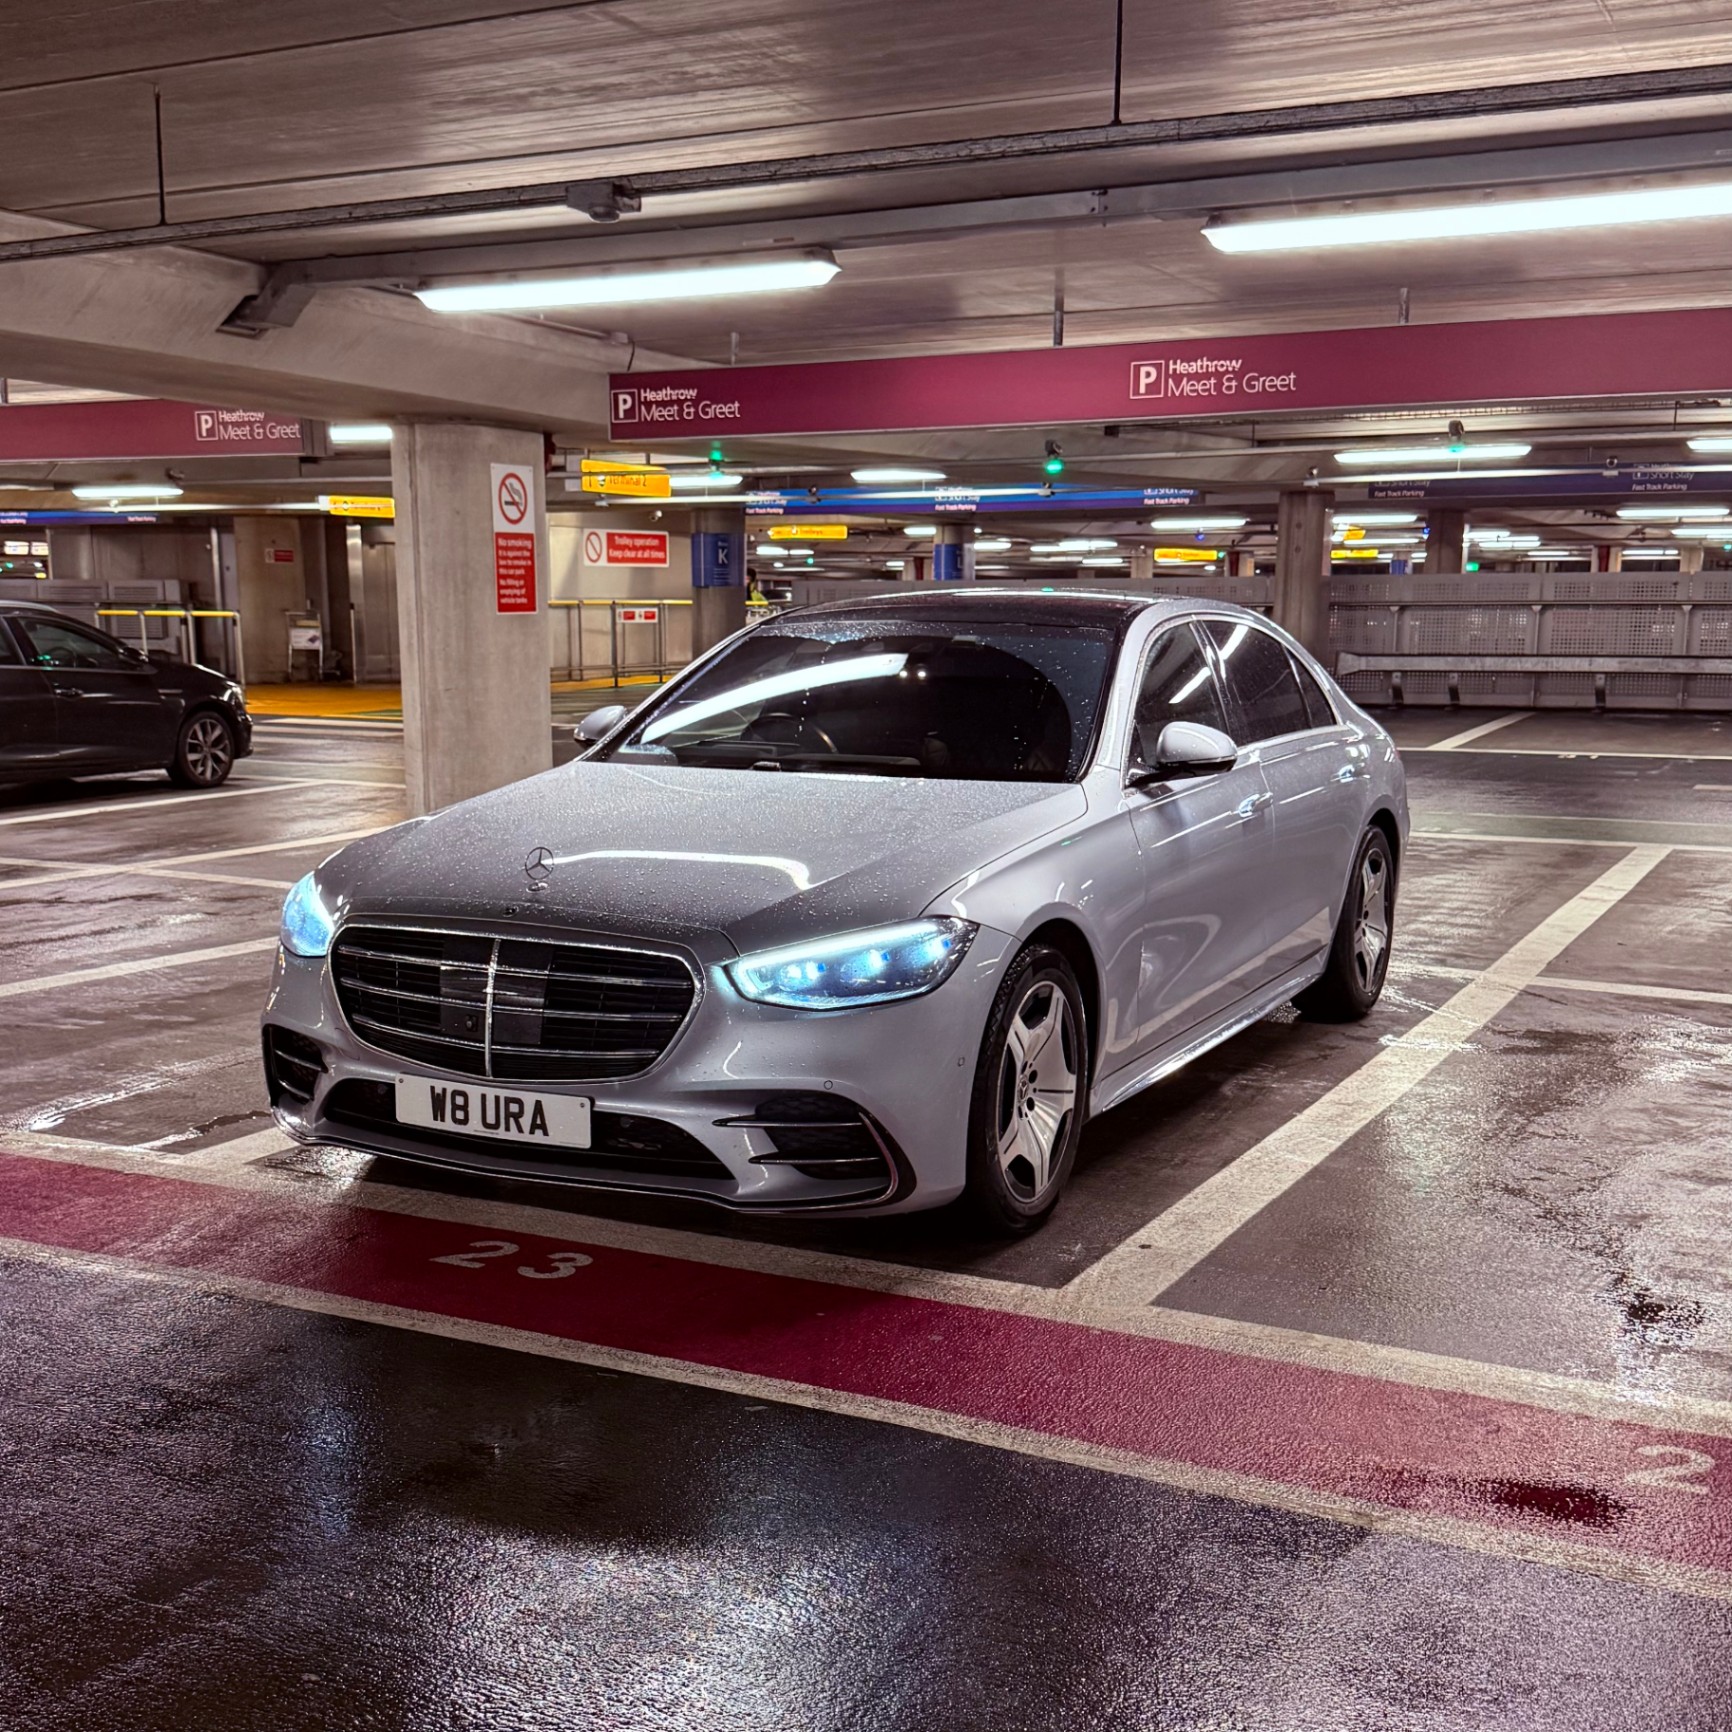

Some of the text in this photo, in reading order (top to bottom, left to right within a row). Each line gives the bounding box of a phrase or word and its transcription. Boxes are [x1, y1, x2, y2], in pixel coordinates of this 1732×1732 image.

[1168, 356, 1242, 375] Heathrow
[1139, 366, 1157, 394] P
[1168, 372, 1297, 397] Meet & Greet
[640, 386, 698, 402] Heathrow
[618, 394, 632, 419] P
[640, 400, 741, 422] Meet & Greet
[218, 410, 265, 422] Heathrow
[200, 414, 213, 437] P
[219, 422, 302, 440] Meet & Greet
[1402, 490, 1425, 498] Parking
[1662, 483, 1688, 491] Parking
[498, 538, 533, 550] No smoking
[614, 535, 660, 548] Trolley operation
[608, 548, 622, 559] Keep
[623, 548, 636, 558] clear
[637, 549, 643, 558] at
[650, 549, 666, 559] times
[718, 548, 729, 565] K
[430, 1085, 550, 1137] W8 URA
[428, 1240, 594, 1279] 23
